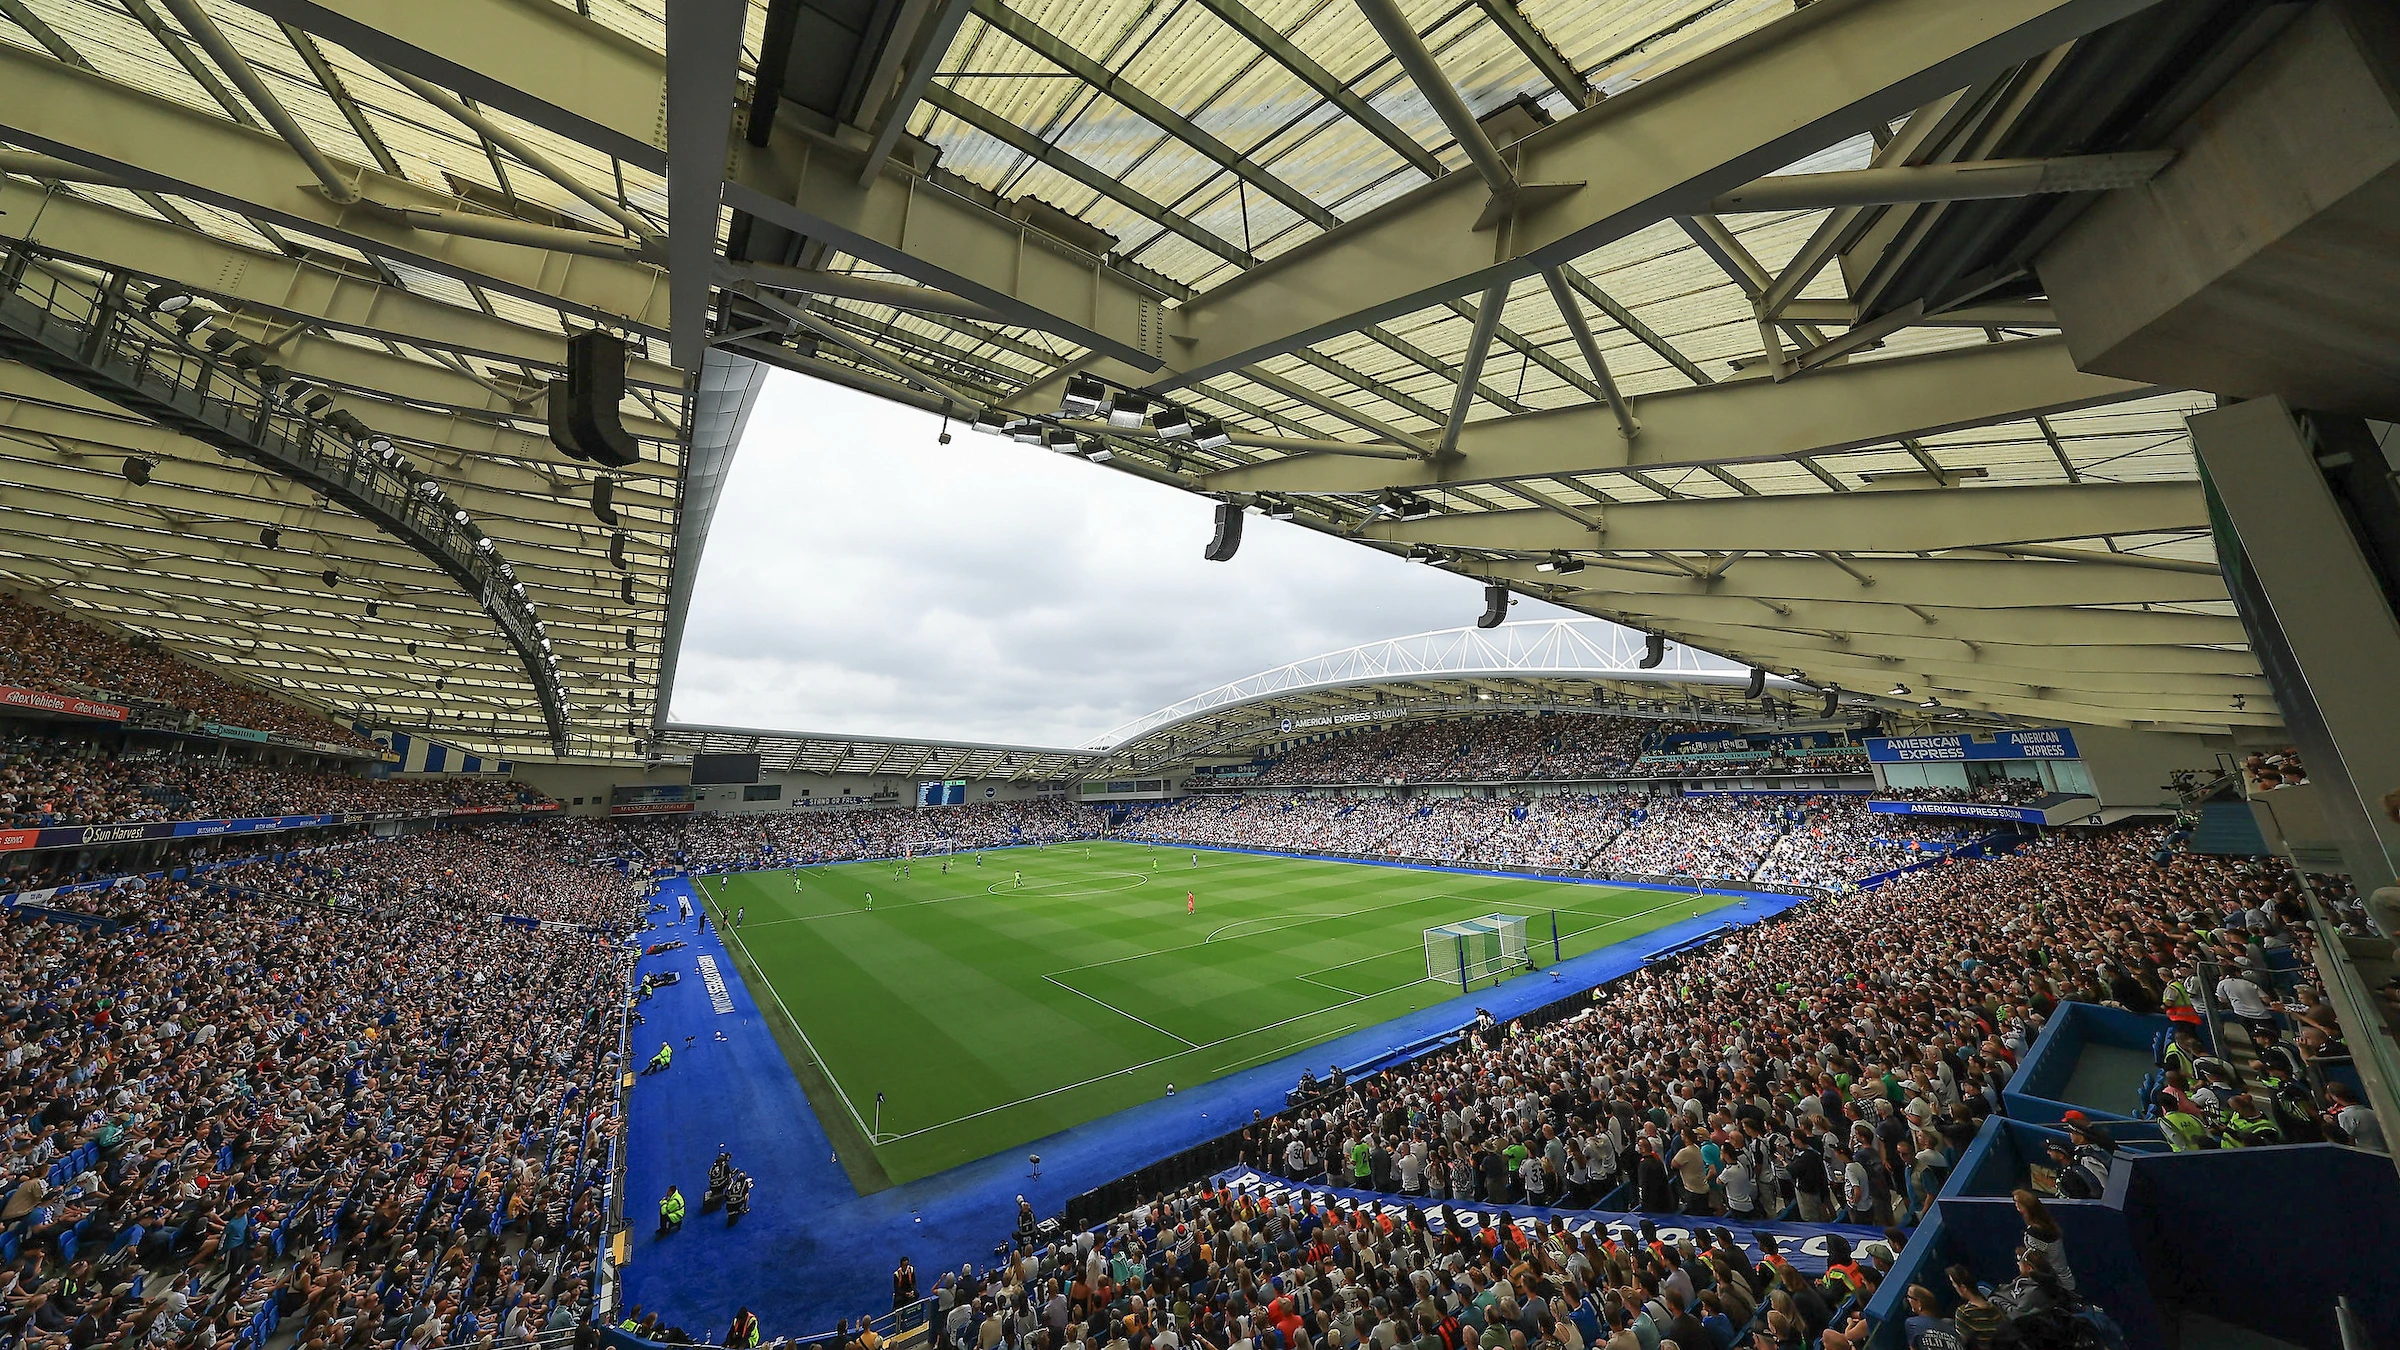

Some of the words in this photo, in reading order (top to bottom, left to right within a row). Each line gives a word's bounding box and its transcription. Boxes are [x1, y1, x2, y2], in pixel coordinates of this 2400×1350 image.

[12, 691, 30, 704] Rex
[30, 694, 66, 710] Vehicles
[92, 704, 121, 719] Vehicles
[1295, 716, 1332, 728] AMERICAN
[1334, 712, 1371, 724] EXPRESS
[1373, 707, 1407, 720] STADIUM
[1887, 736, 1961, 750] AMERICAN
[2011, 731, 2060, 745] AMERICAN
[1899, 747, 1965, 760] EXPRESS
[2023, 744, 2065, 757] EXPRESS
[809, 798, 830, 806] STAND
[831, 797, 840, 805] OR
[841, 796, 857, 804] FALL
[1910, 804, 1960, 815] AMERICAN
[1960, 807, 1999, 817] EXPRESS
[1999, 808, 2022, 819] STADIUM
[4, 835, 25, 845] SERVICE
[93, 828, 110, 842] Sun
[112, 826, 144, 840] Harvest
